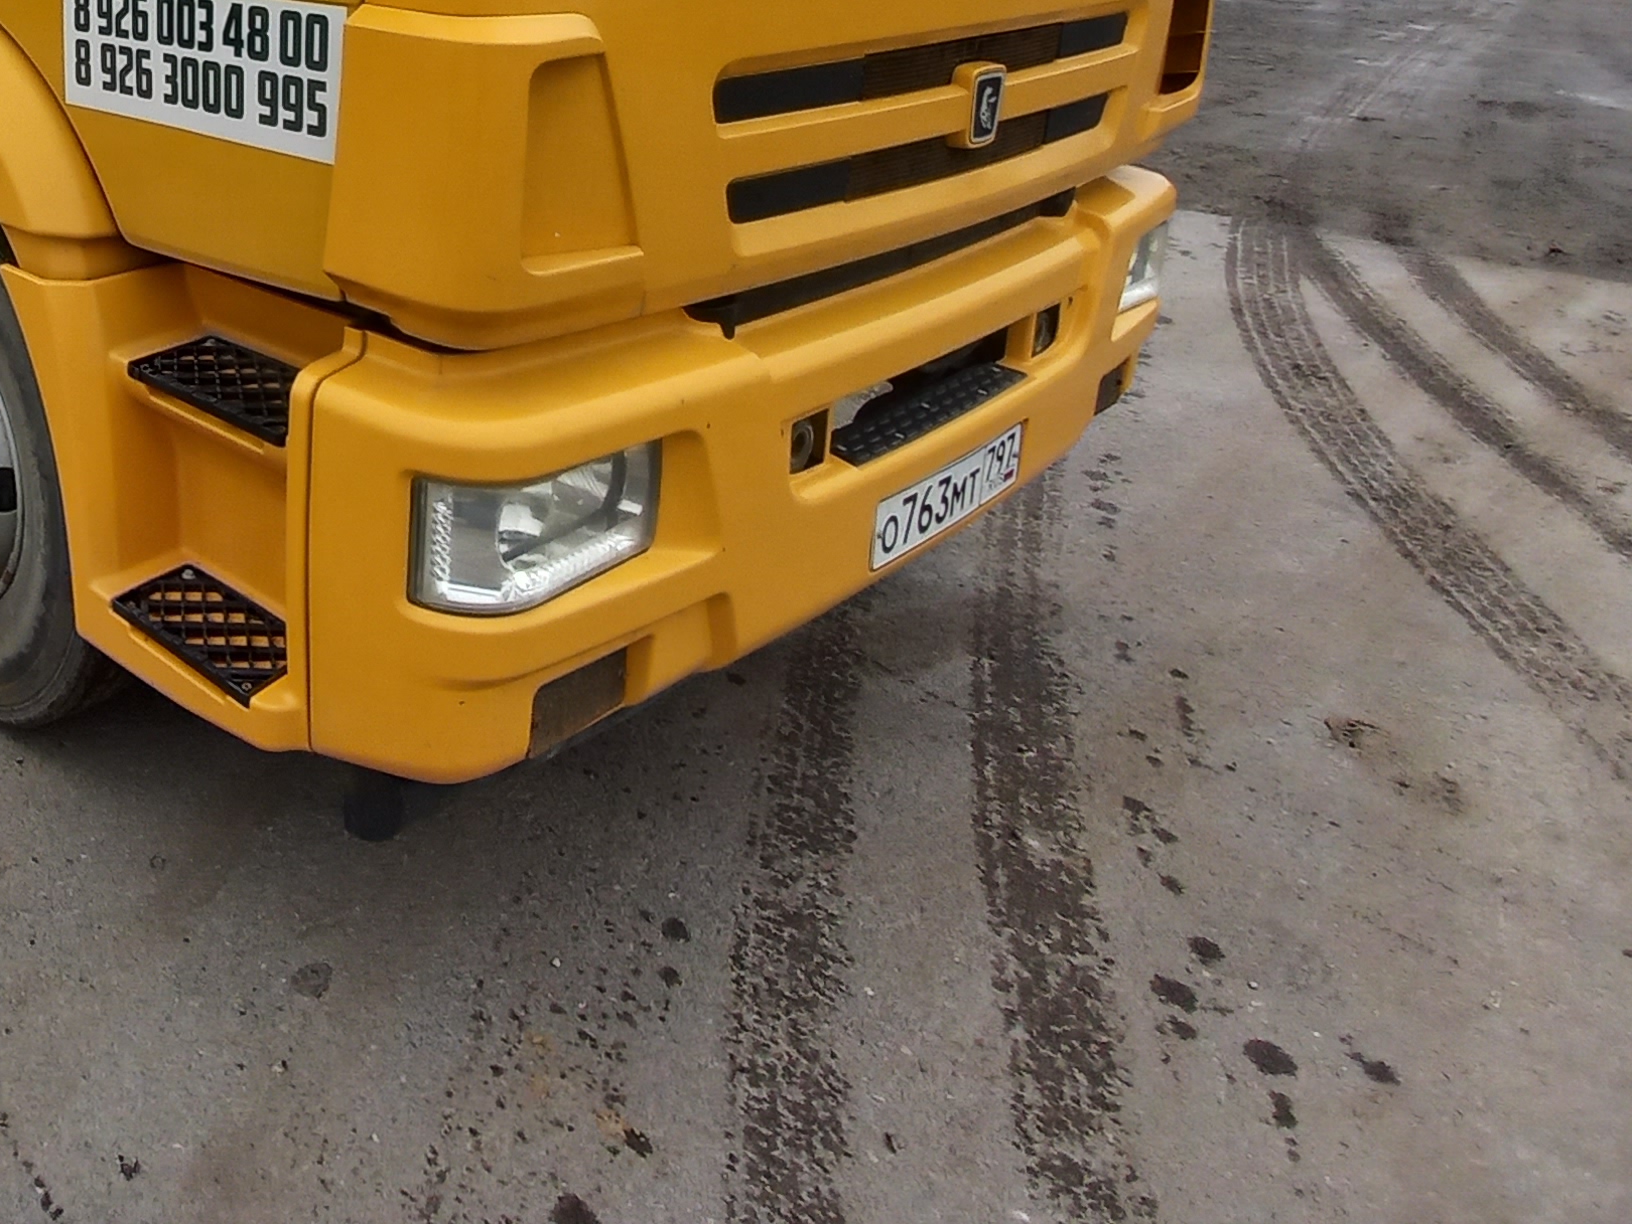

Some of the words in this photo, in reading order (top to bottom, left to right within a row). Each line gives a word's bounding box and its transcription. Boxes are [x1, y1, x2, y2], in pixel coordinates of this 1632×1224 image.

[222, 3, 270, 62] 48
[279, 10, 329, 72] 00
[75, 39, 92, 86] 8
[100, 43, 153, 99] 926
[162, 52, 244, 119] 3000
[257, 70, 327, 137] 995
[985, 432, 1016, 483] 797
